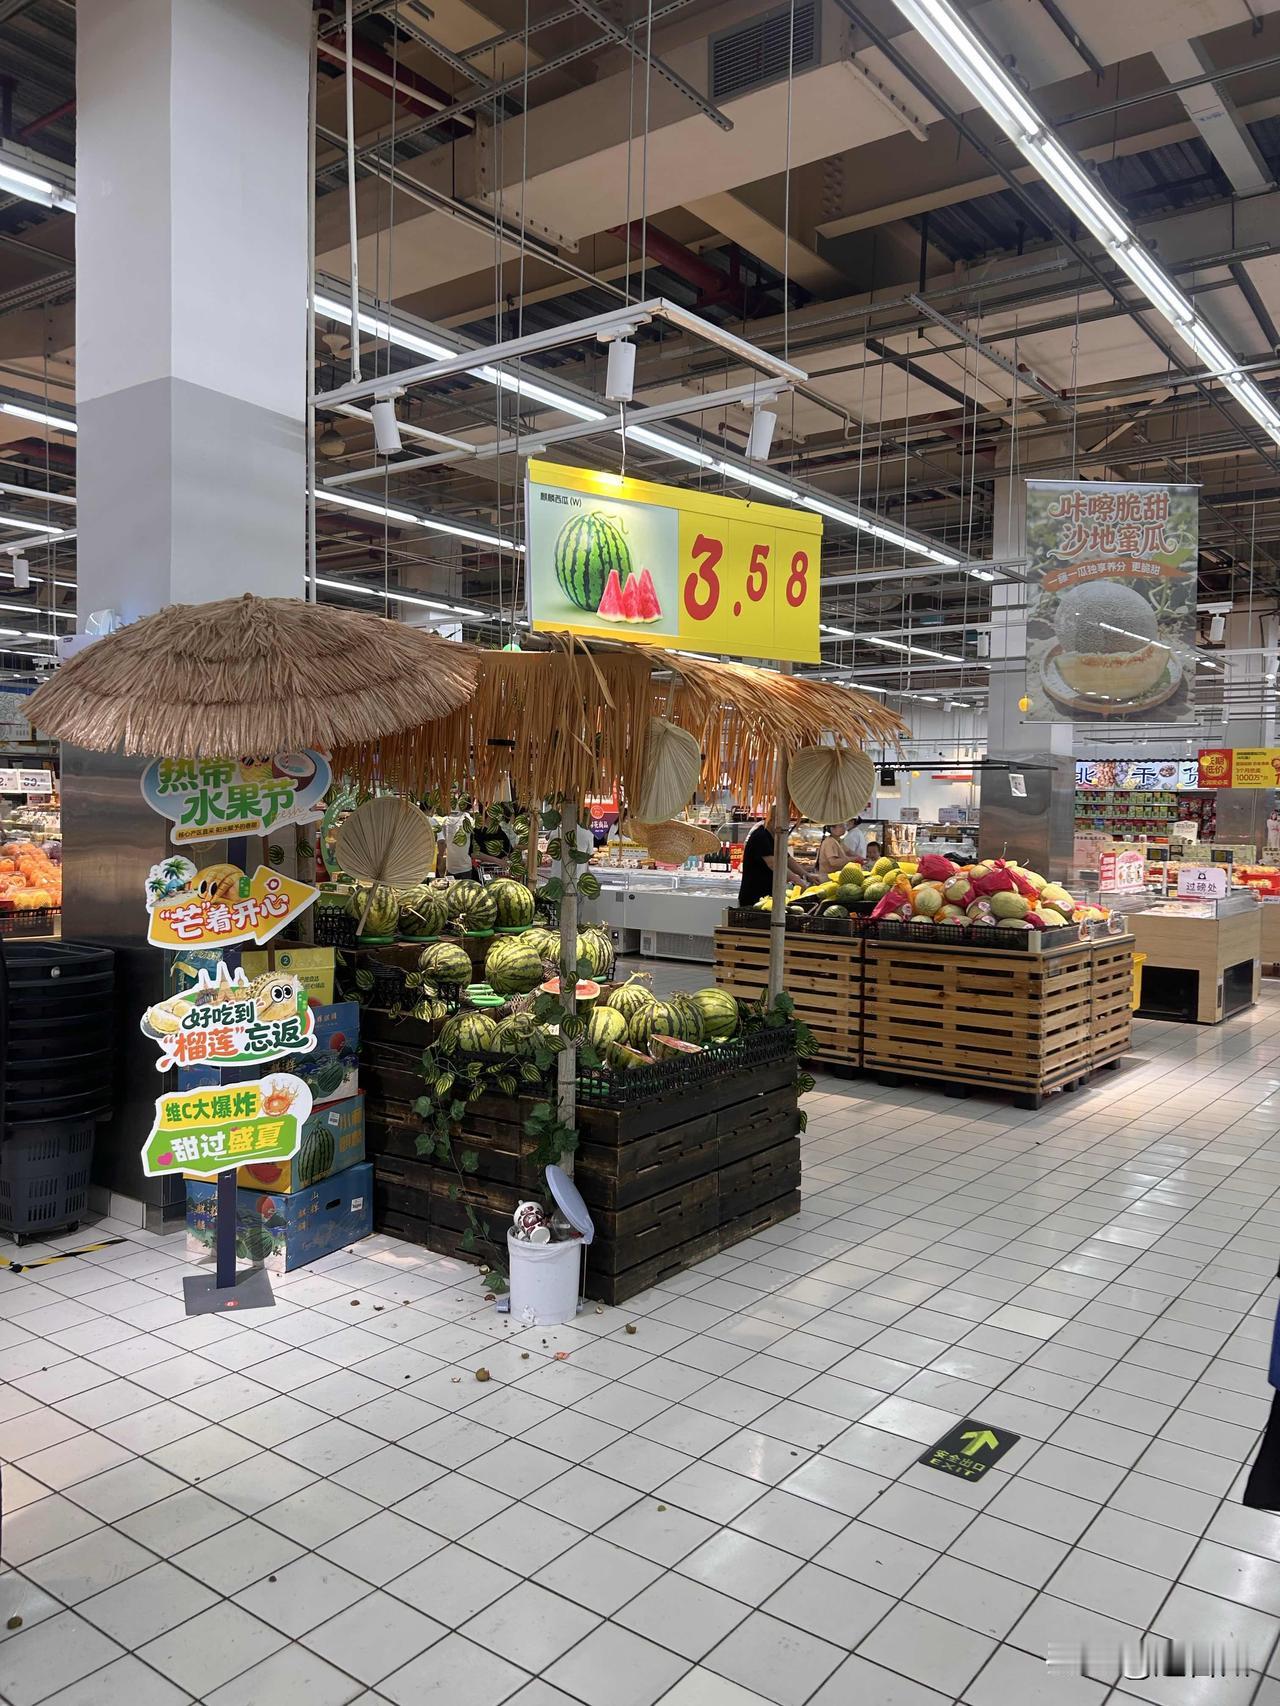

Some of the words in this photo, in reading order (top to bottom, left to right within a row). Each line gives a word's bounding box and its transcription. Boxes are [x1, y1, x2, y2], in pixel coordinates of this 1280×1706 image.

[1049, 489, 1170, 523] 咔嚓脆甜
[1047, 522, 1178, 560] 沙地蜜瓜
[684, 533, 809, 621] 3.58
[157, 757, 237, 795] 热带
[180, 777, 298, 829] 水果节
[1186, 882, 1217, 893] 过磅处
[182, 1001, 255, 1030] 好吃到
[165, 1091, 257, 1122] 维C大爆炸
[169, 1121, 284, 1163] 甜过盛夏
[929, 1457, 975, 1476] EXIT
[933, 1449, 986, 1472] 安全出口
